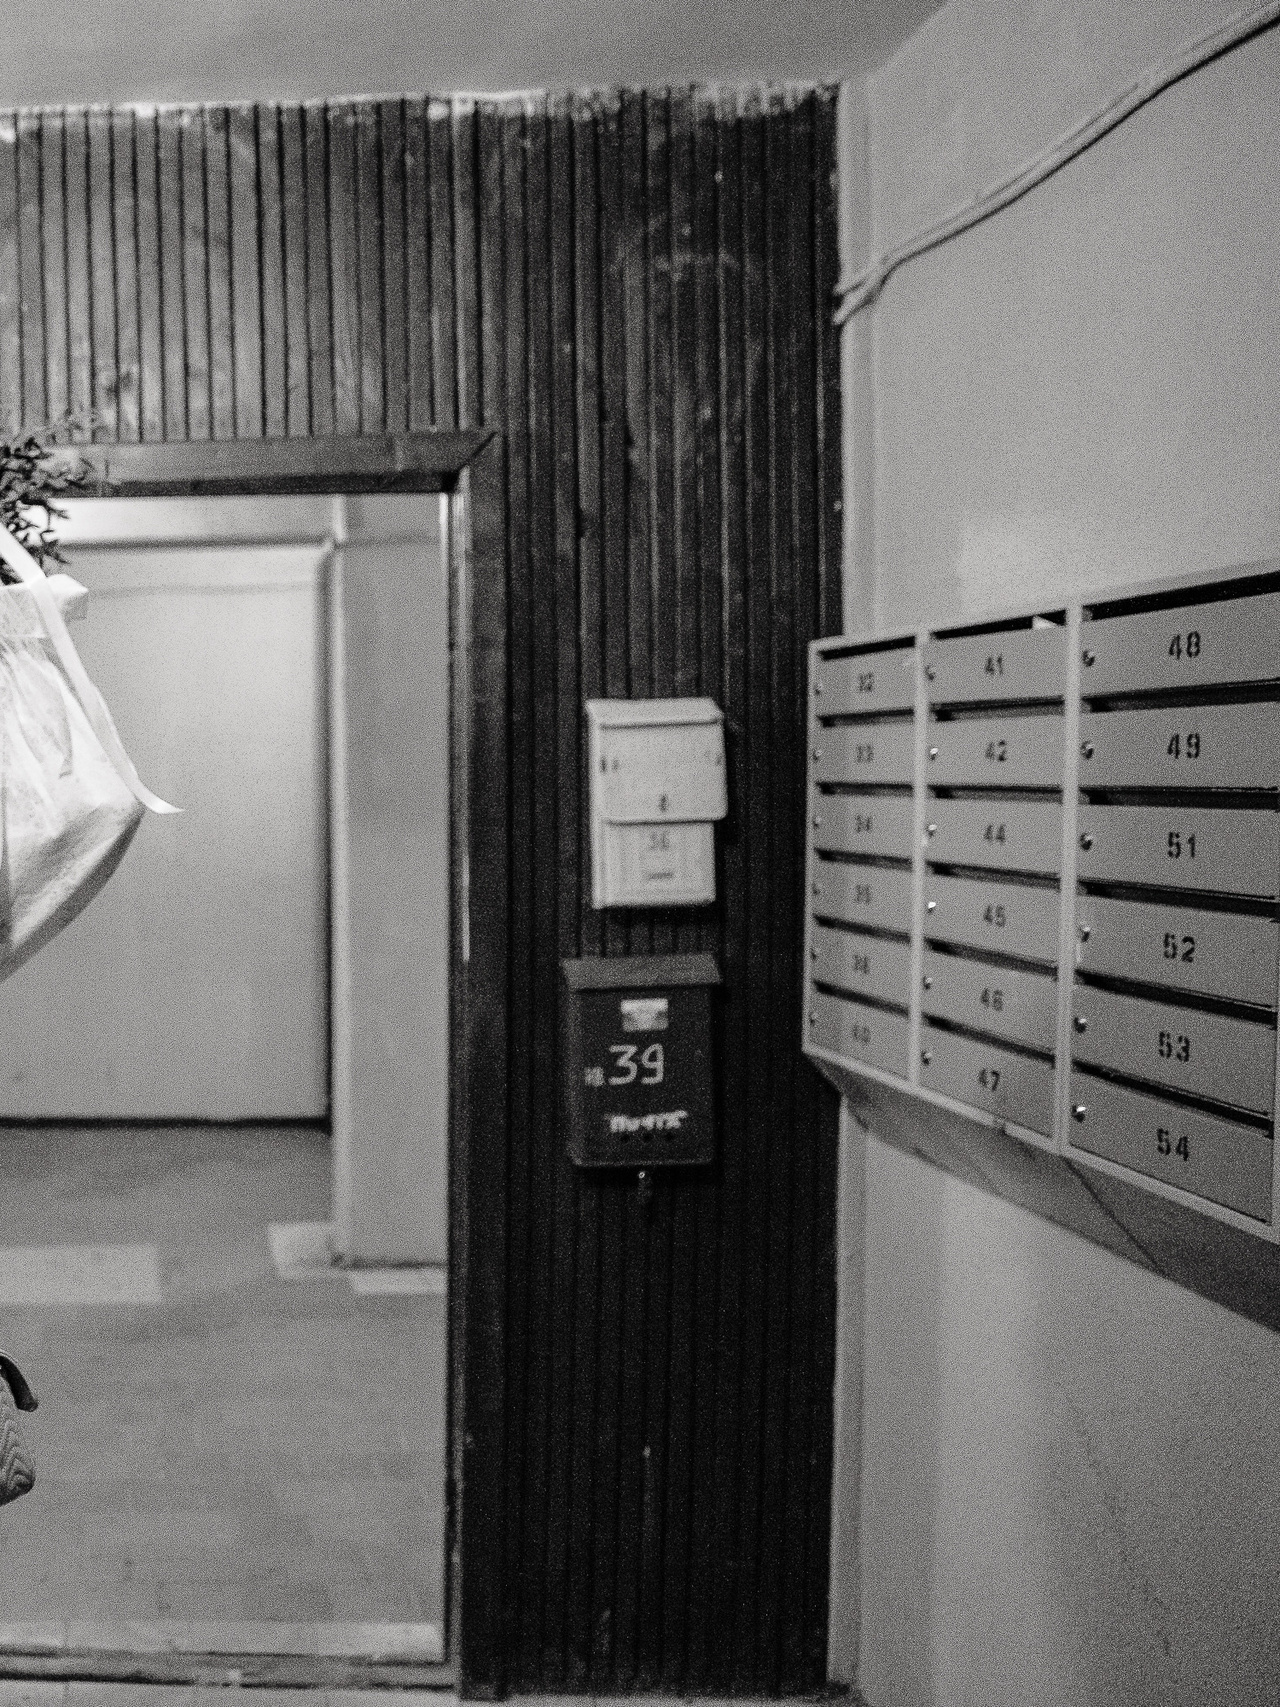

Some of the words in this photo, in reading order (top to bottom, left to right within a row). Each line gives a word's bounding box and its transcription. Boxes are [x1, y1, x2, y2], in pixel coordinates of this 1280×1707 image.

[1168, 630, 1201, 660] 48
[984, 653, 1003, 676] 41
[985, 739, 1006, 762] 42
[1166, 732, 1199, 760] 49
[984, 823, 1005, 846] 44
[1167, 831, 1196, 860] 51
[983, 904, 1006, 928] 45
[1163, 931, 1195, 963] 52
[980, 987, 1003, 1012] 46
[1159, 1030, 1190, 1063] 53
[978, 1068, 1001, 1092] 47
[1156, 1127, 1190, 1163] 54
